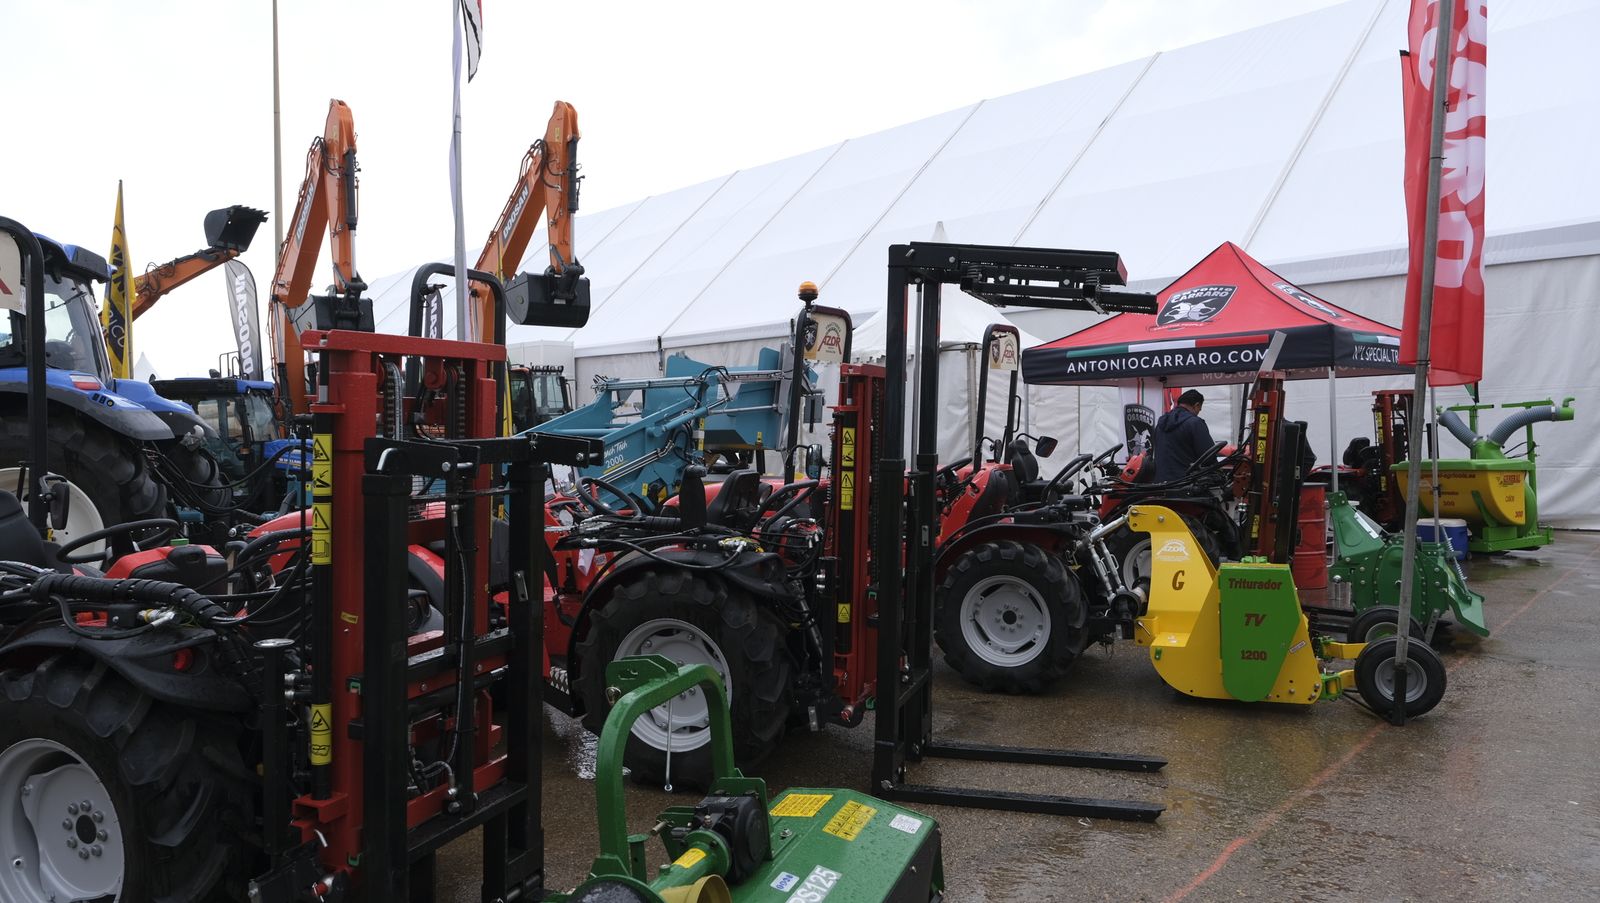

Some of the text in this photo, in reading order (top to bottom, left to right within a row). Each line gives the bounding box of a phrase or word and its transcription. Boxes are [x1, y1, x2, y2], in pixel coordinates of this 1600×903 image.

[297, 183, 314, 241] DOOSAN
[503, 185, 529, 240] DOOSAN
[1171, 290, 1229, 303] CARRARO
[1066, 348, 1269, 374] ANTONIOCARRARO.COM
[1365, 347, 1391, 362] SPECIAL
[605, 454, 624, 468] 2000
[1172, 570, 1185, 591] G
[1228, 578, 1283, 590] Triturador
[1244, 613, 1267, 627] TV
[1240, 649, 1267, 661] 1200
